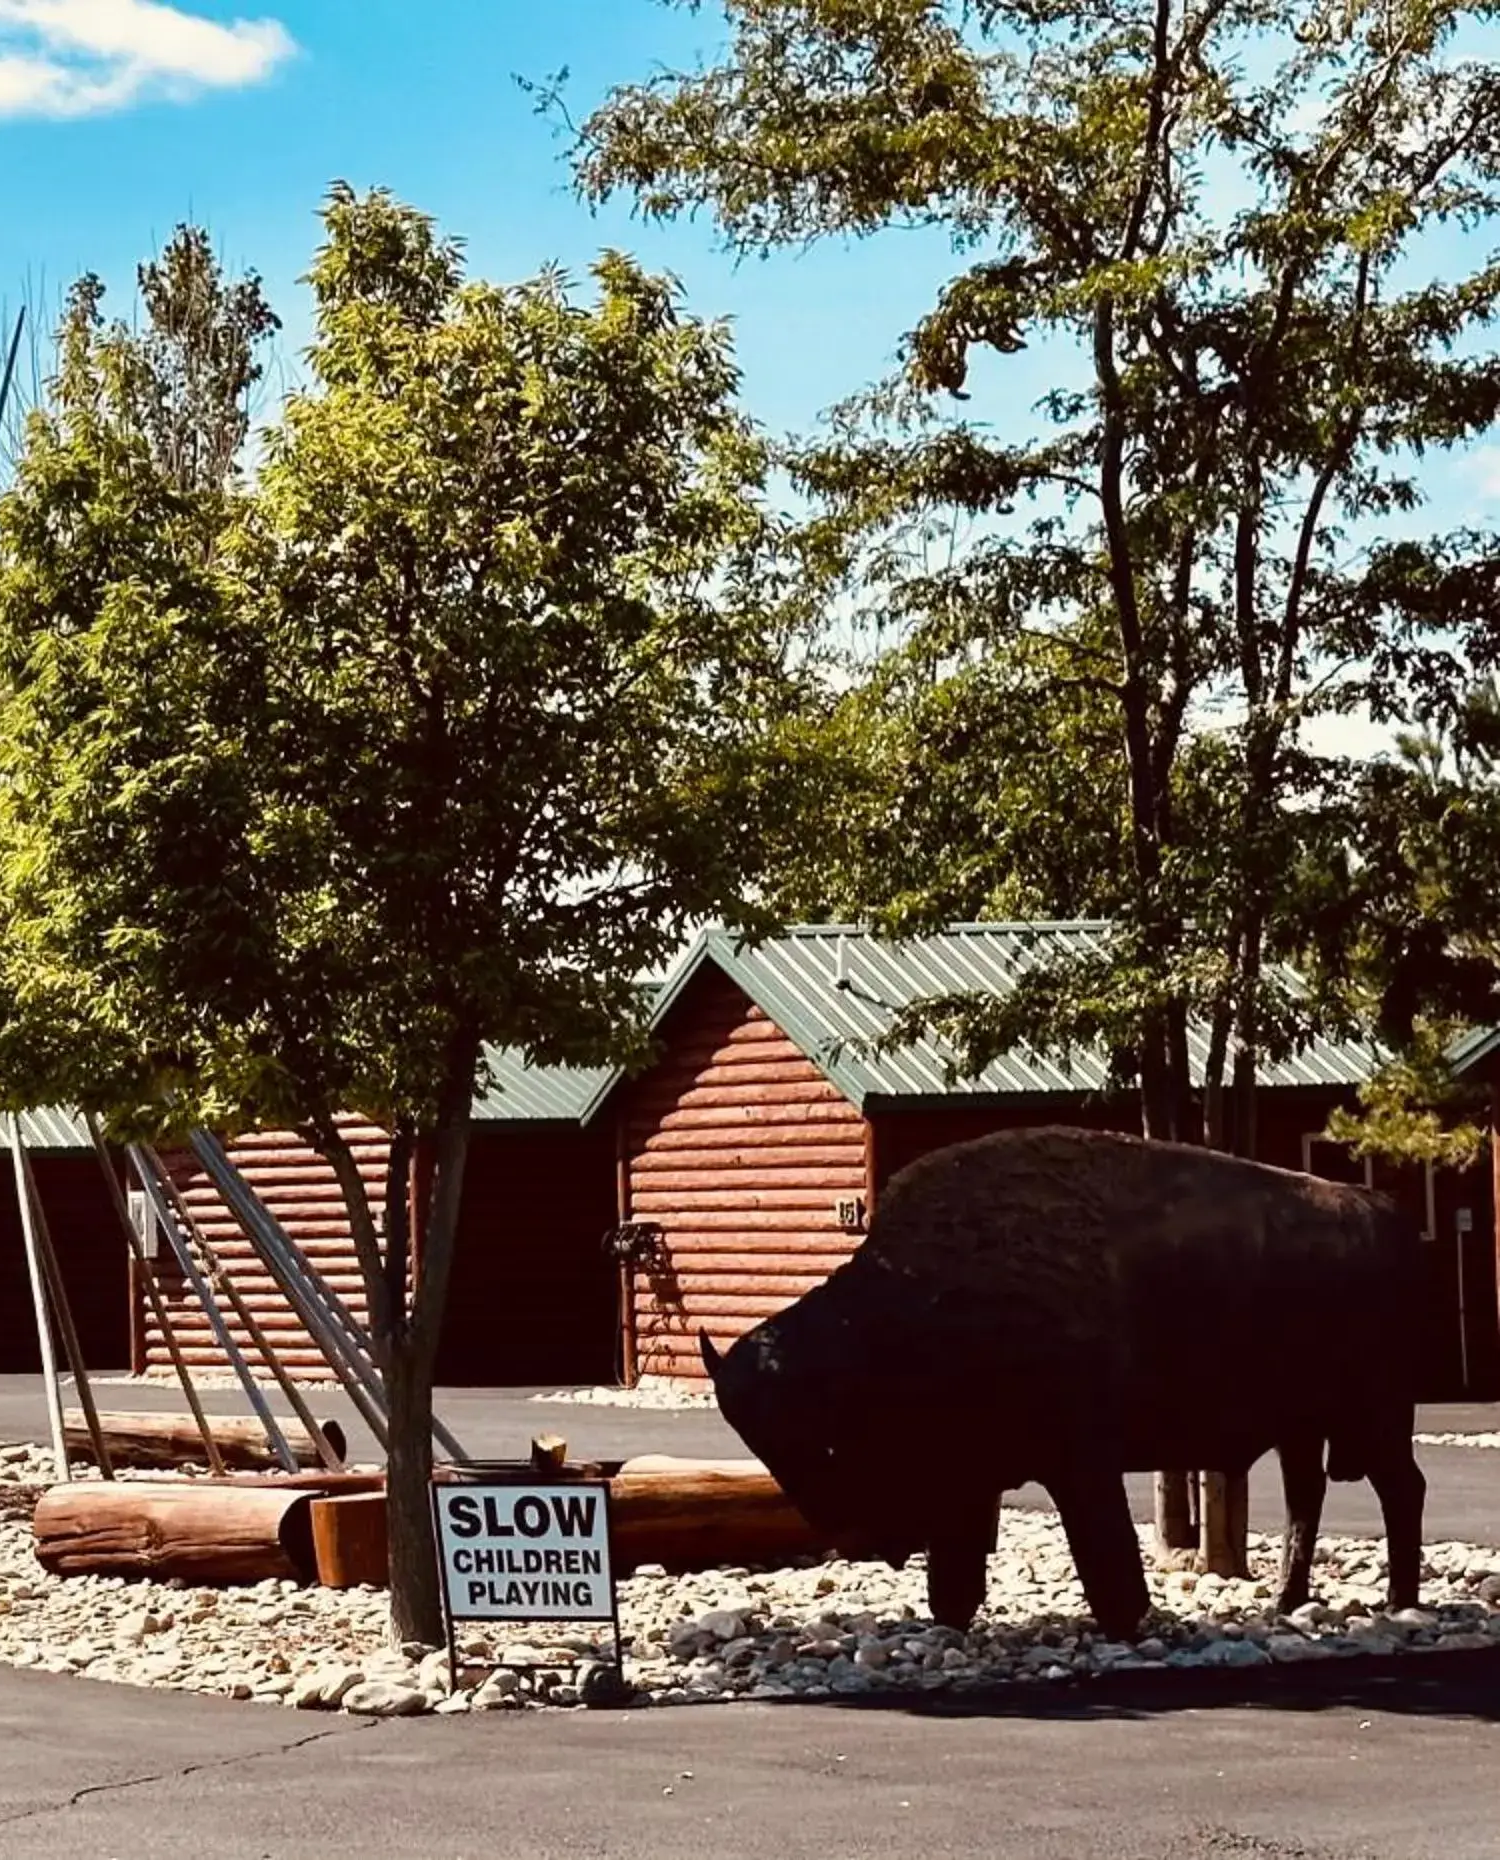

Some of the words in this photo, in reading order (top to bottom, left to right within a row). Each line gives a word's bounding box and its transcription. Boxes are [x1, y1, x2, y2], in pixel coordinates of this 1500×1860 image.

[447, 1495, 597, 1538] SLOW
[452, 1548, 602, 1575] CHILDREN
[467, 1580, 593, 1607] PLAYING
